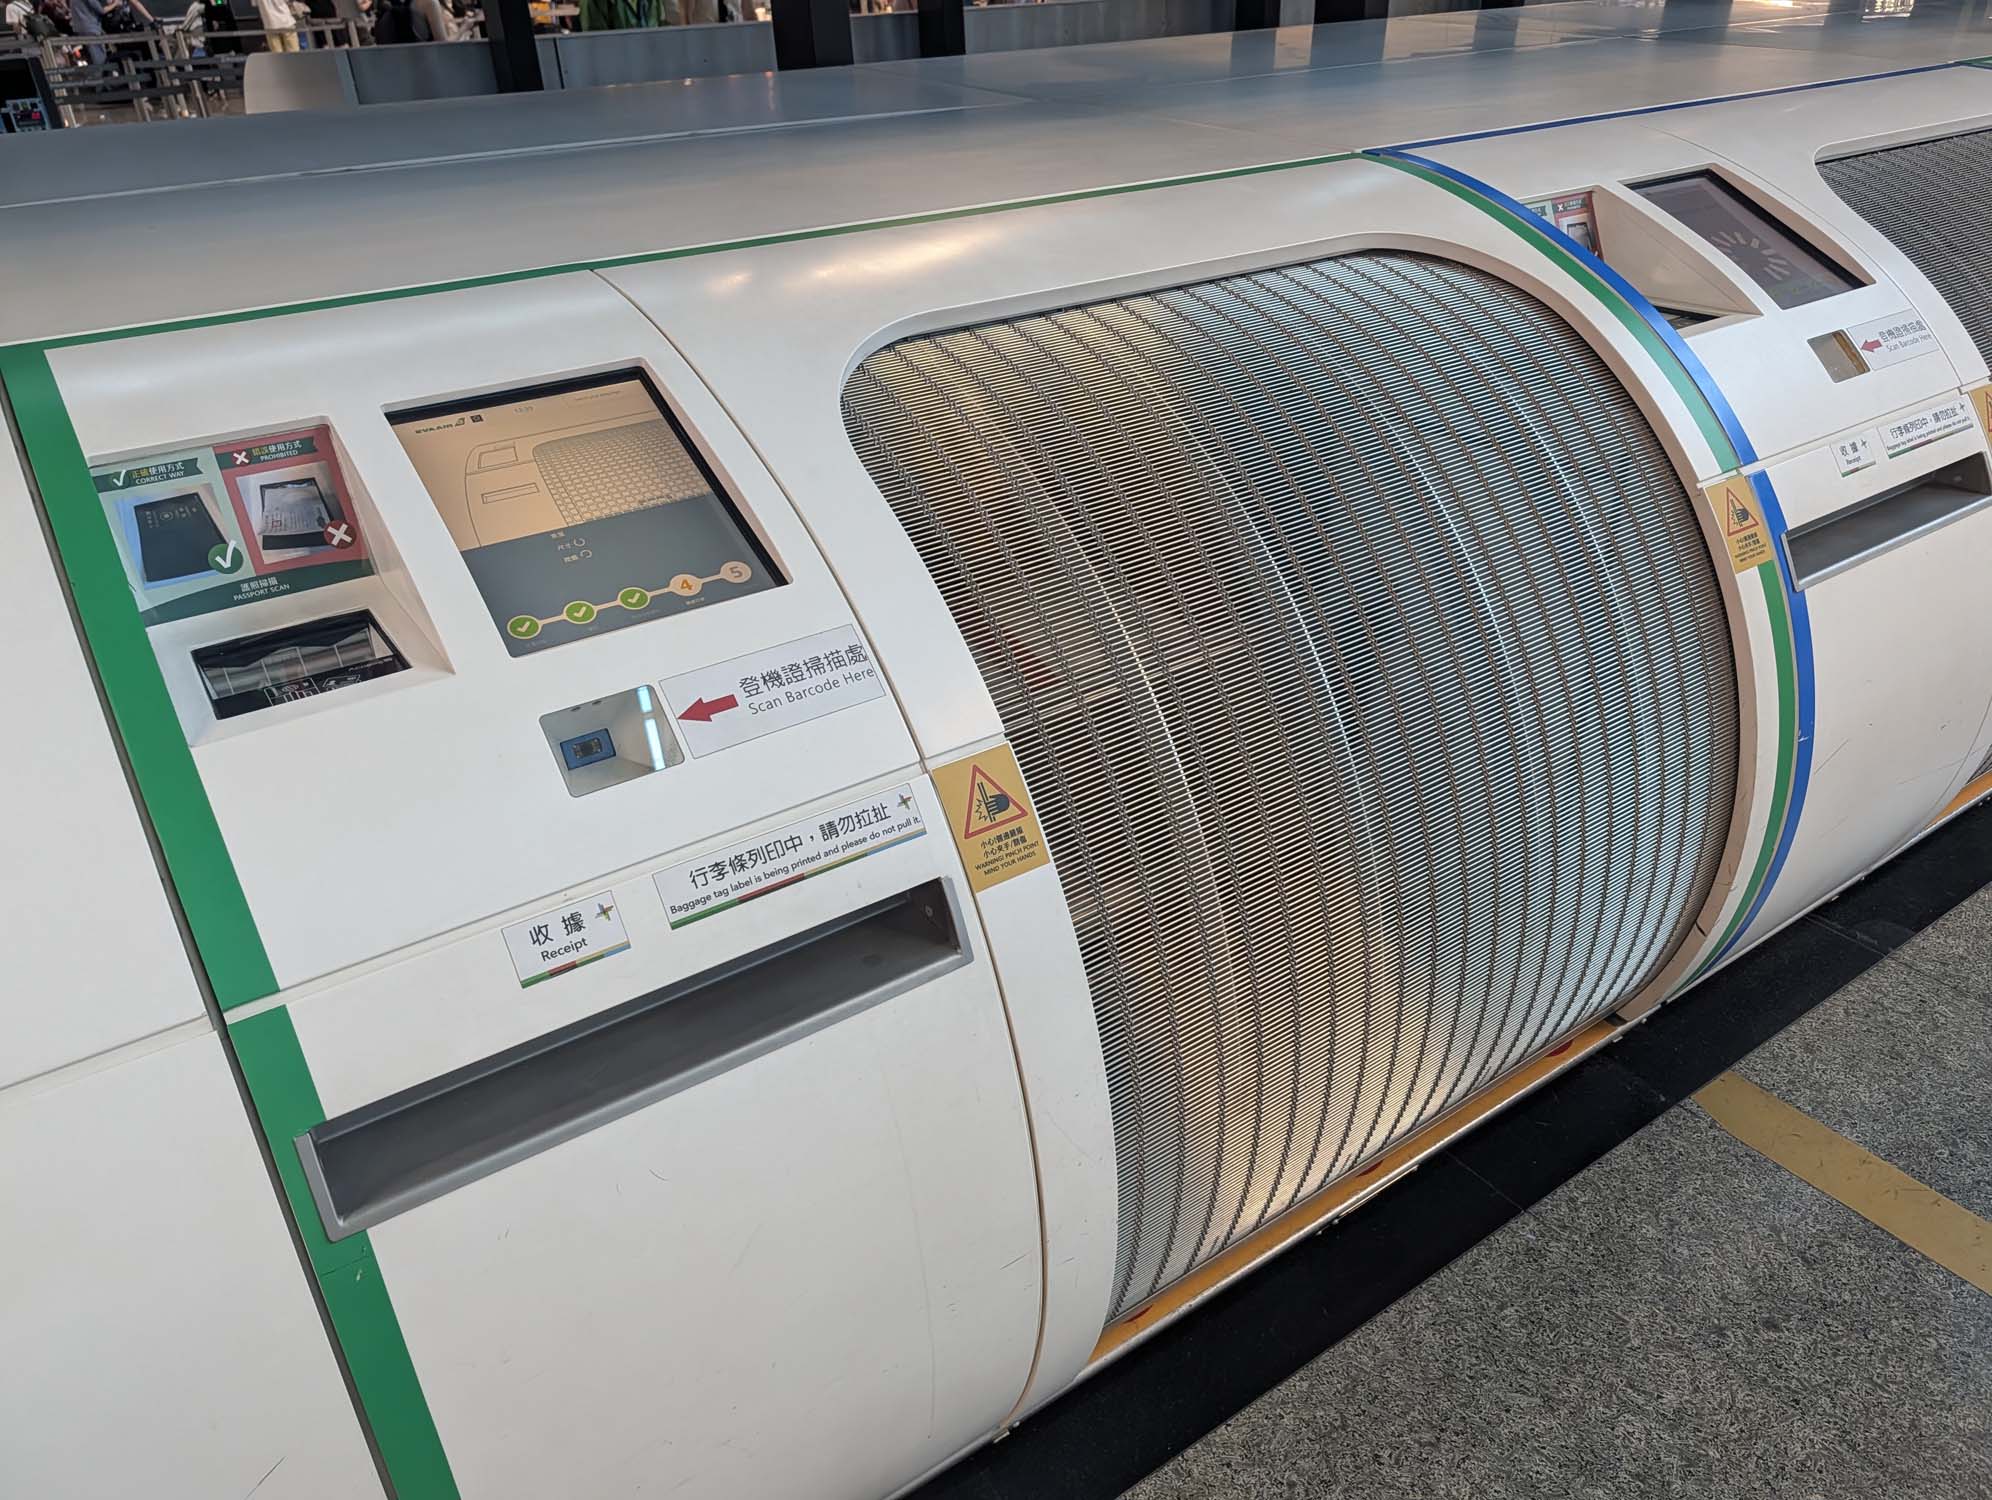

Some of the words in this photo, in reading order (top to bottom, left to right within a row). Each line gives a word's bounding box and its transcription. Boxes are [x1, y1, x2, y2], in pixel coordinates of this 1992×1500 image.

[260, 450, 298, 461] PROHIBITED
[135, 474, 168, 485] CORRECT
[168, 471, 184, 479] WAY
[680, 578, 693, 591] 4
[730, 566, 743, 578] 5
[233, 588, 269, 601] PASSPORT
[269, 583, 290, 593] SCAN
[739, 644, 869, 699] 登機證掃描處
[748, 696, 783, 716] Scan
[784, 678, 841, 704] Barcode
[843, 667, 876, 686] Here
[689, 803, 892, 889] 行李條列印中，請勿拉扯
[975, 855, 1005, 871] WARNING!
[1005, 849, 1023, 859] PINCH
[1023, 840, 1039, 852] POINT
[669, 894, 712, 914] Baggage
[713, 887, 730, 898] tag
[730, 876, 754, 893] label
[754, 874, 763, 884] is
[763, 863, 790, 880] being
[791, 851, 822, 873] printed
[823, 845, 841, 858] and
[841, 835, 868, 853] please
[869, 829, 881, 841] do
[882, 824, 896, 836] not
[897, 816, 913, 833] pull
[912, 815, 922, 826] it.
[984, 866, 1000, 876] MIND
[1000, 859, 1017, 869] YOUR
[1017, 850, 1037, 863] HANDS
[529, 911, 586, 947] 收據
[541, 937, 588, 962] Receipt
